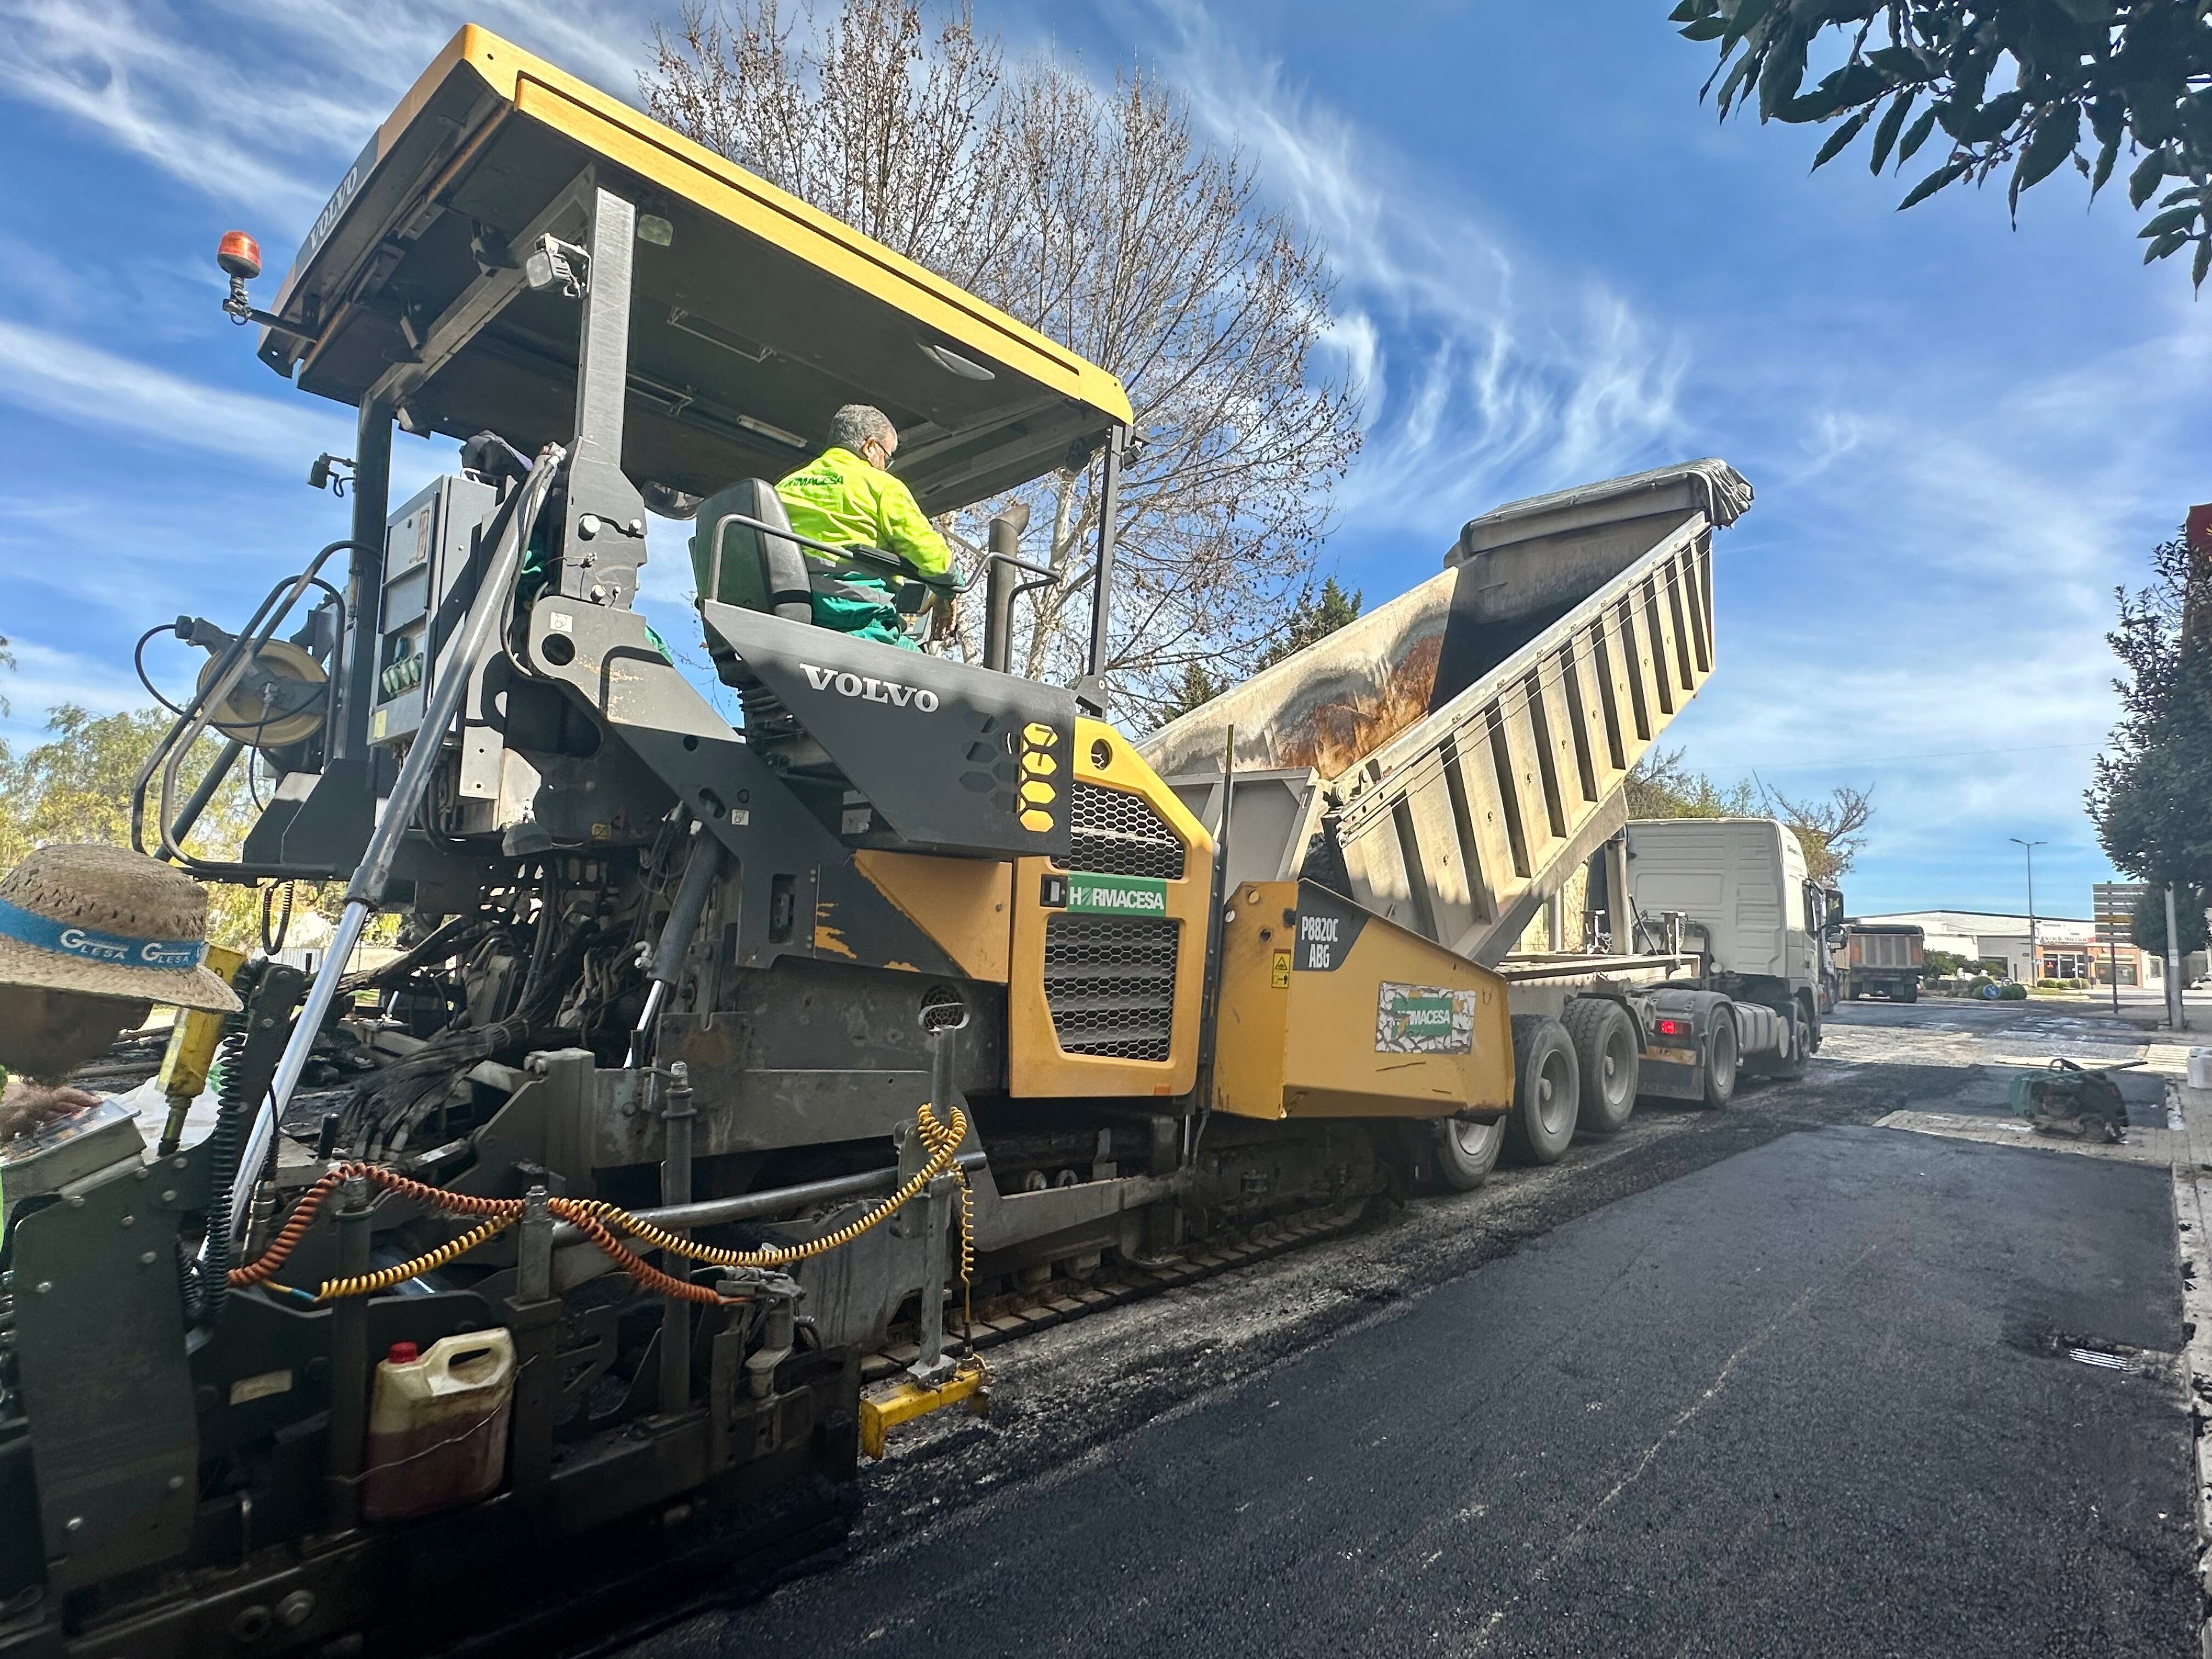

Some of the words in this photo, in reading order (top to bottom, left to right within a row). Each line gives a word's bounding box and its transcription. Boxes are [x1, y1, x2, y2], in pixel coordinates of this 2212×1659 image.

[310, 167, 358, 250] VOLVO
[799, 663, 939, 712] VOLVO
[1301, 916, 1339, 942] P8820C
[1308, 944, 1330, 968] ABG
